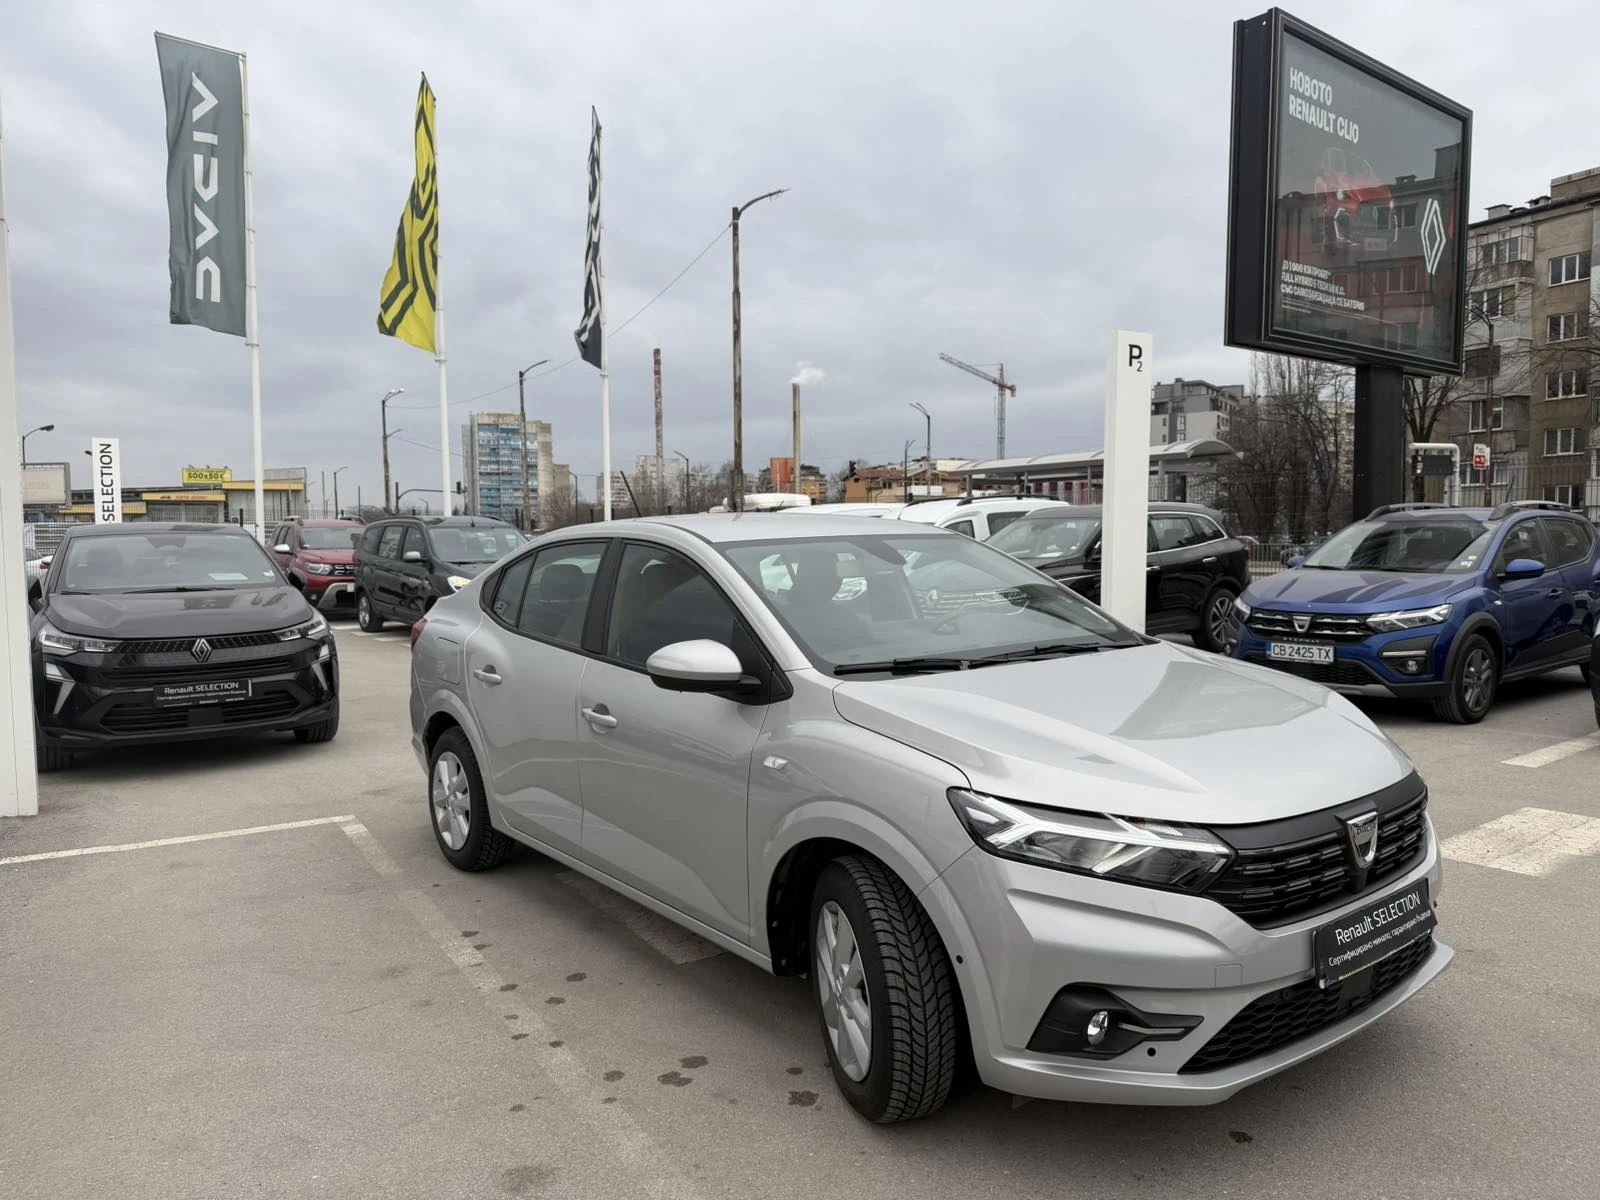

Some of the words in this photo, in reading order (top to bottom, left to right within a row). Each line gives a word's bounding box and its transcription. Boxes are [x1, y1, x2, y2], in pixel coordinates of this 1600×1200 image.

[1289, 66, 1333, 106] НОВОТО
[1289, 94, 1336, 134] RENAULT
[1336, 115, 1359, 145] CLIO
[99, 443, 115, 521] SELECTION
[1288, 646, 1314, 658] 2425
[164, 686, 194, 694] Renault
[195, 682, 239, 691] SELECTION
[1335, 915, 1374, 945] Renault
[1373, 891, 1421, 927] SELECTION
